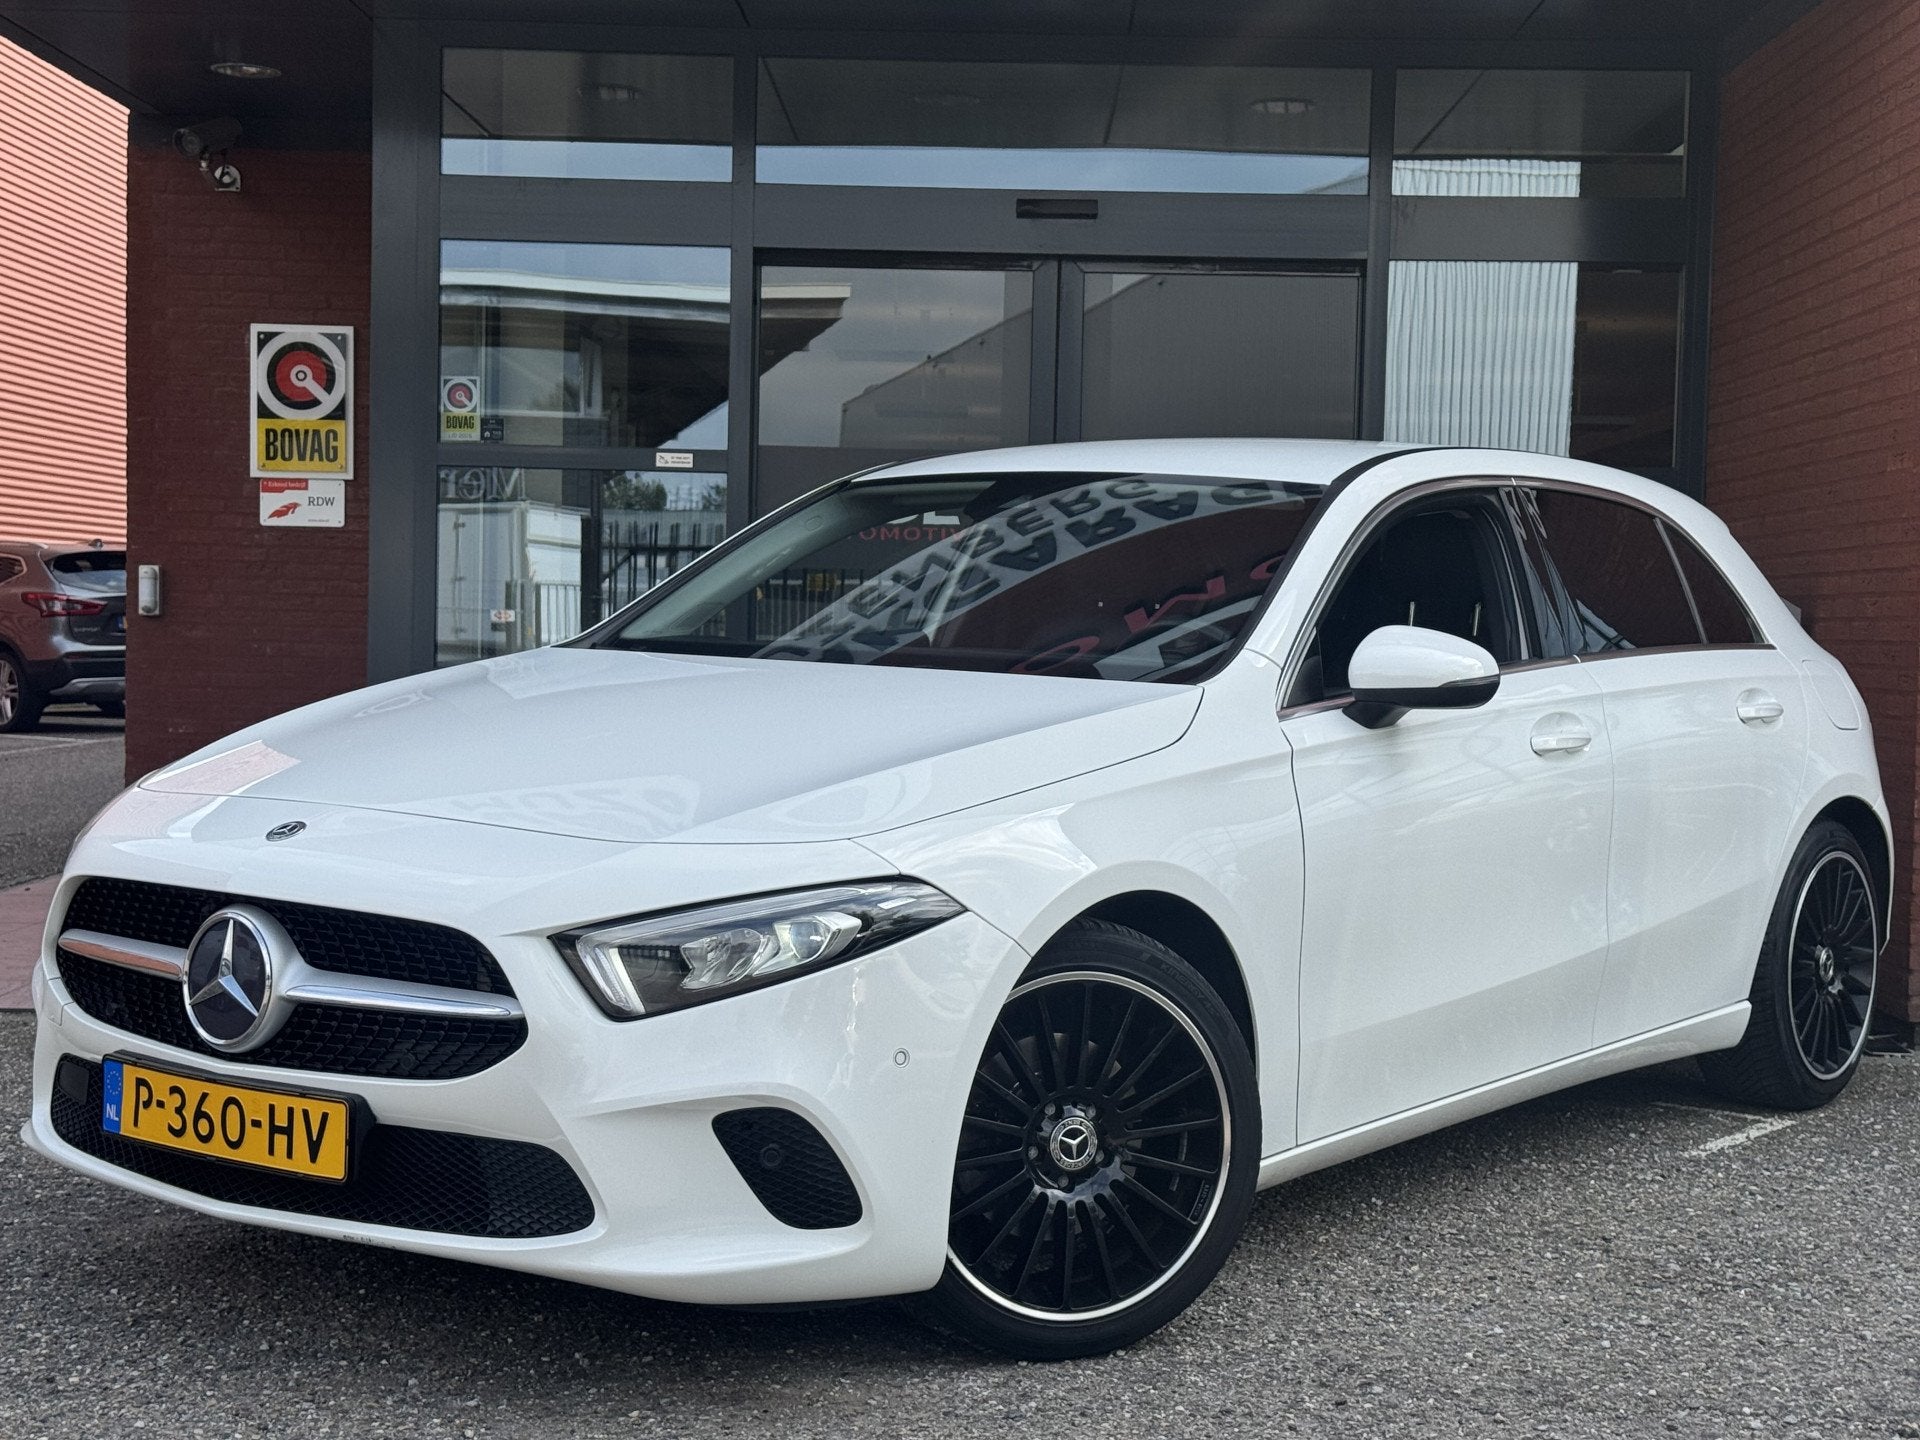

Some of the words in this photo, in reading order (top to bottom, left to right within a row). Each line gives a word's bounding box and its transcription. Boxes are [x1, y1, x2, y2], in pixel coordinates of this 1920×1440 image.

[446, 415, 475, 430] BOVAG
[265, 427, 338, 463] BOVAG
[308, 496, 336, 507] RDW
[106, 1103, 119, 1121] NL
[133, 1076, 329, 1164] P-360-HV
